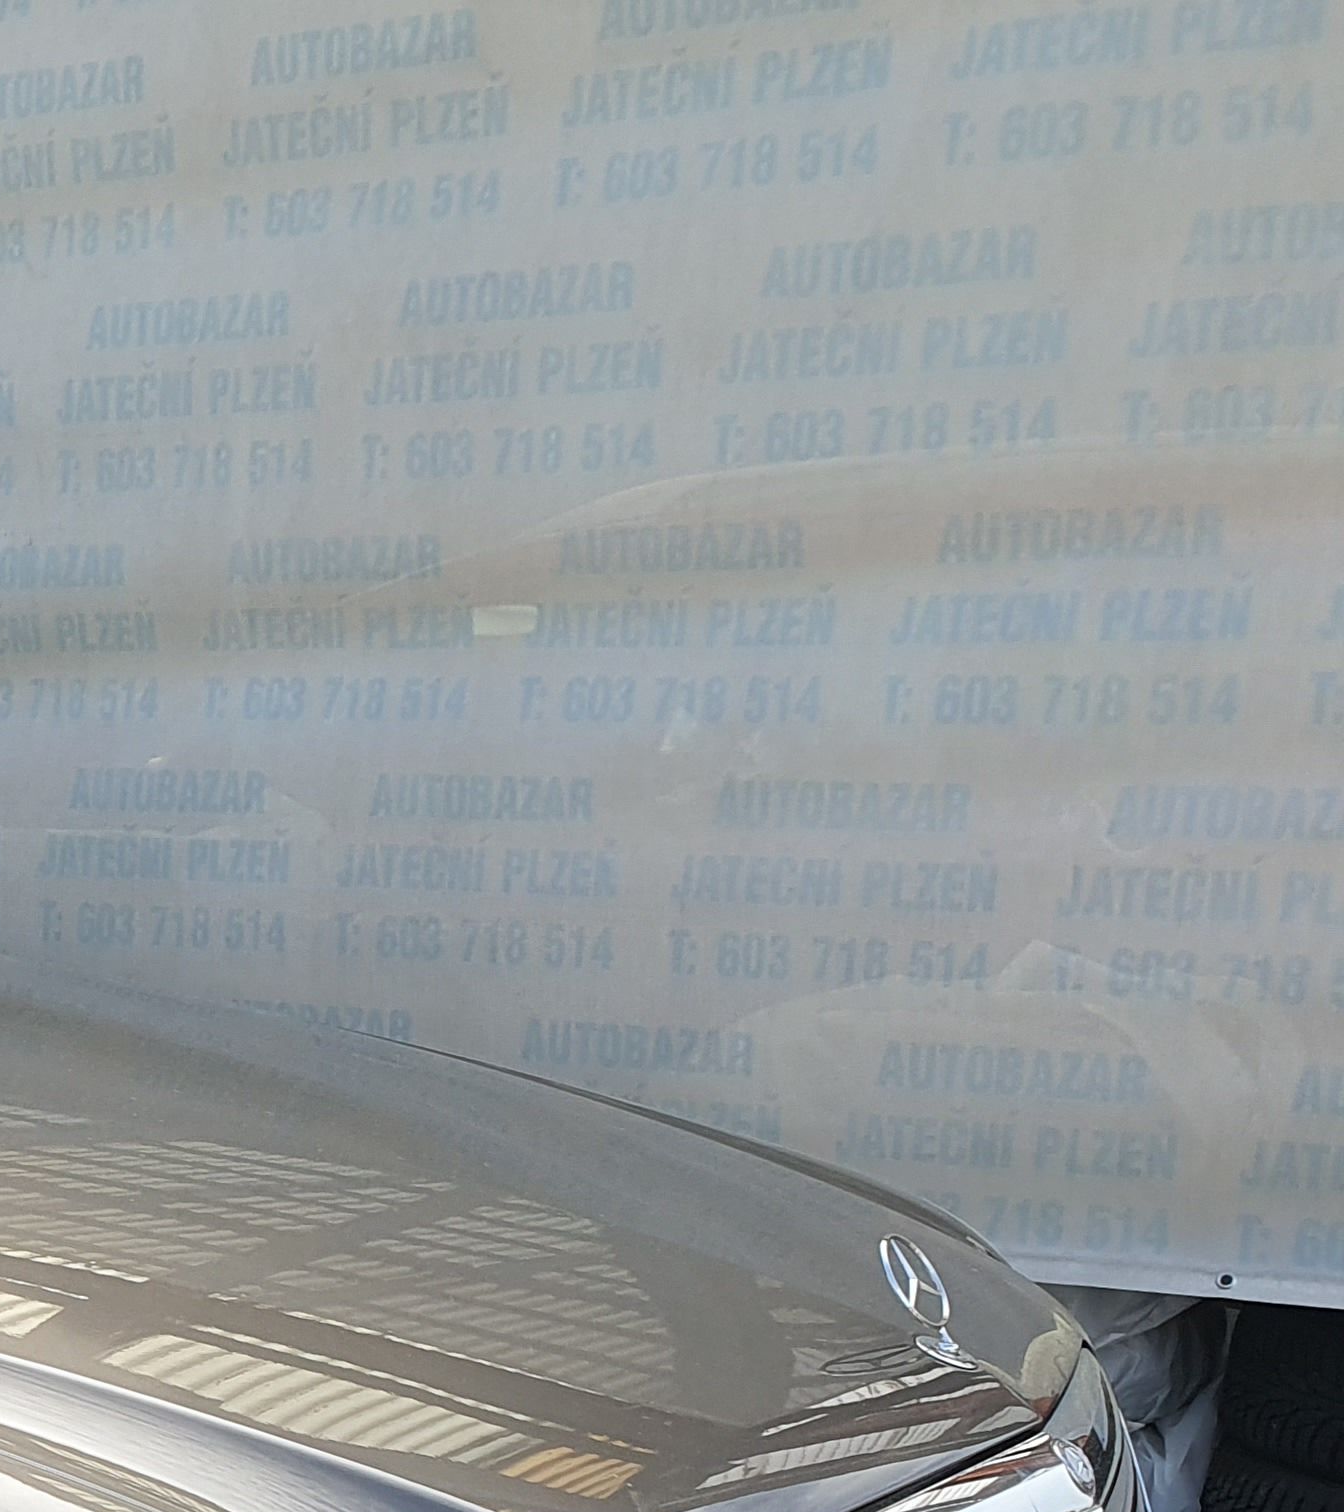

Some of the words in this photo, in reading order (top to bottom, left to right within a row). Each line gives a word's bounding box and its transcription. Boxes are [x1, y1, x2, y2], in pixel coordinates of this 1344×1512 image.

[250, 7, 477, 88] AUTOBAZAR
[561, 41, 737, 128] JATEČNÍ
[752, 19, 893, 105] PLZEŇ
[72, 113, 176, 184] PLZEŇ
[223, 88, 373, 167] JATEČNÍ
[390, 70, 509, 148] PLZEŇ
[999, 101, 1088, 162] 603
[1114, 91, 1204, 153] 718
[1224, 85, 1312, 141] 514
[603, 148, 680, 201] 603
[702, 135, 778, 191] 718
[798, 126, 878, 183] 514
[42, 211, 100, 258] 718
[115, 203, 174, 256] 514
[265, 188, 330, 238] 603
[349, 178, 416, 227] 718
[430, 168, 501, 223] 514
[760, 225, 1039, 298] AUTOBAZAR
[86, 289, 290, 351] AUTOBAZAR
[398, 261, 635, 328] AUTOBAZAR
[59, 357, 196, 424] JATEČNÍ
[209, 351, 316, 416] PLZEŇ
[365, 335, 521, 407] JATEČNÍ
[537, 324, 663, 394] PLZEŇ
[407, 430, 475, 478] 603
[494, 426, 564, 474] 718
[581, 421, 656, 474] 514
[766, 411, 843, 464] 603
[866, 403, 947, 456] 718
[969, 399, 1056, 451] 514
[96, 447, 156, 493] 603
[173, 442, 232, 490] 718
[250, 439, 311, 485] 514
[226, 534, 442, 584] AUTOBAZAR
[557, 520, 805, 575] AUTOBAZAR
[937, 505, 1224, 567] AUTOBAZAR
[203, 595, 346, 650] JATEČNÍ
[364, 594, 474, 649] PLZEŇ
[704, 580, 837, 646] PLZEŇ
[889, 579, 1081, 644] JATEČNÍ
[1099, 573, 1251, 642] PLZEŇ
[244, 678, 305, 721] 603
[323, 677, 387, 721] 718
[397, 677, 467, 720] 514
[935, 674, 1018, 724] 603
[1043, 674, 1129, 724] 718
[1148, 674, 1240, 725] 514
[69, 768, 266, 813] AUTOBAZAR
[369, 772, 594, 822] AUTOBAZAR
[715, 781, 970, 833] AUTOBAZAR
[38, 823, 173, 881] JATEČNÍ
[187, 828, 290, 882] PLZEŇ
[337, 834, 491, 893] JATEČNÍ
[503, 838, 619, 899] PLZEŇ
[861, 848, 999, 914] PLZEŇ
[77, 902, 134, 946] 603
[150, 906, 209, 950] 718
[225, 909, 286, 953] 514
[376, 916, 443, 960] 603
[461, 919, 528, 968] 718
[543, 924, 615, 981] 514
[717, 931, 790, 979] 603
[814, 936, 889, 984] 718
[911, 939, 989, 989] 514
[878, 1039, 1150, 1104] AUTOBAZAR
[987, 1199, 1064, 1249] 718
[1084, 1206, 1170, 1255] 514
